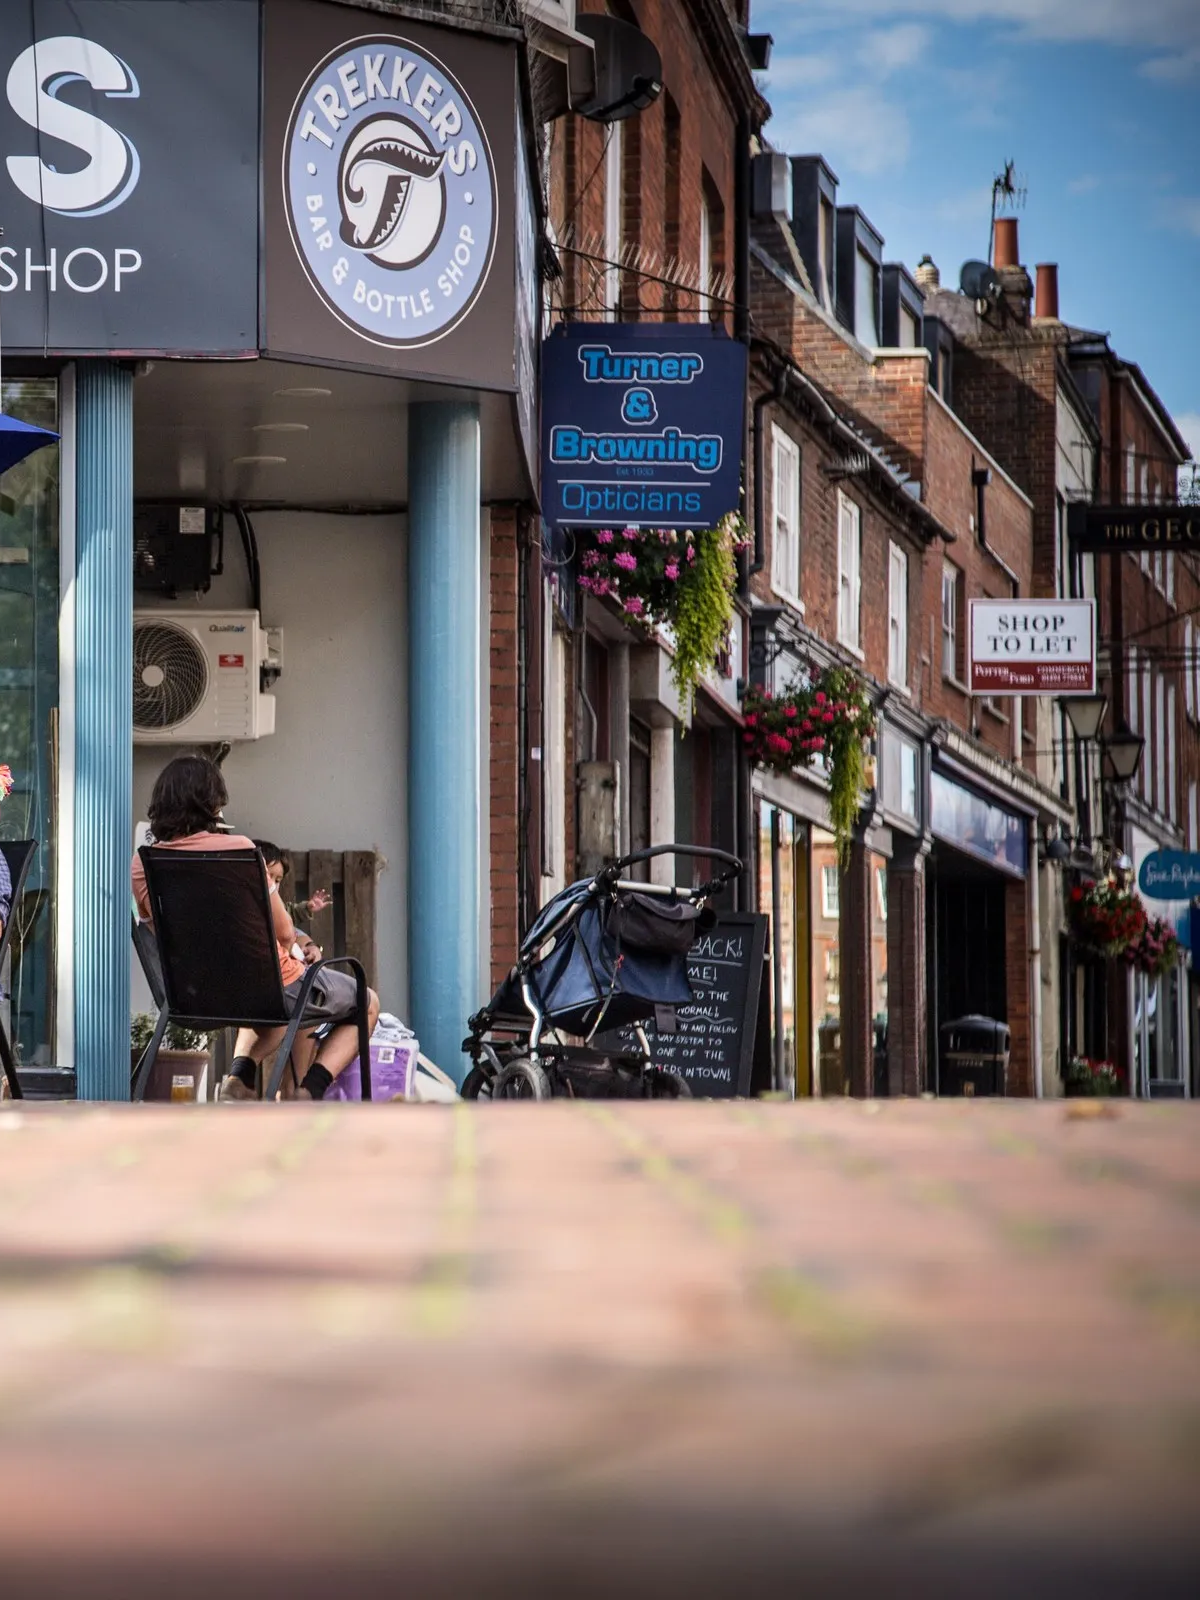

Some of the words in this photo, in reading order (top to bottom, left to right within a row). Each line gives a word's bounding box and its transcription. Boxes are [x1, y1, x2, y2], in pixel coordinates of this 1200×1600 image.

[300, 53, 478, 177] TREKKERS
[305, 193, 334, 252] BAR
[332, 256, 350, 286] &
[352, 279, 435, 320] BOTTLE
[438, 223, 477, 298] SHOP
[581, 349, 700, 381] Turner
[624, 389, 652, 420] &
[554, 429, 719, 471] Browning
[561, 483, 702, 517] Opticians
[1104, 523, 1136, 539] THE
[997, 614, 1066, 634] SHOP
[987, 635, 1021, 654] TO
[1030, 636, 1078, 654] LET
[708, 990, 730, 1003] THE
[708, 1025, 738, 1034] FOLLOW
[708, 1038, 723, 1047] TO
[656, 1047, 676, 1057] ONE
[704, 1049, 725, 1062] THE
